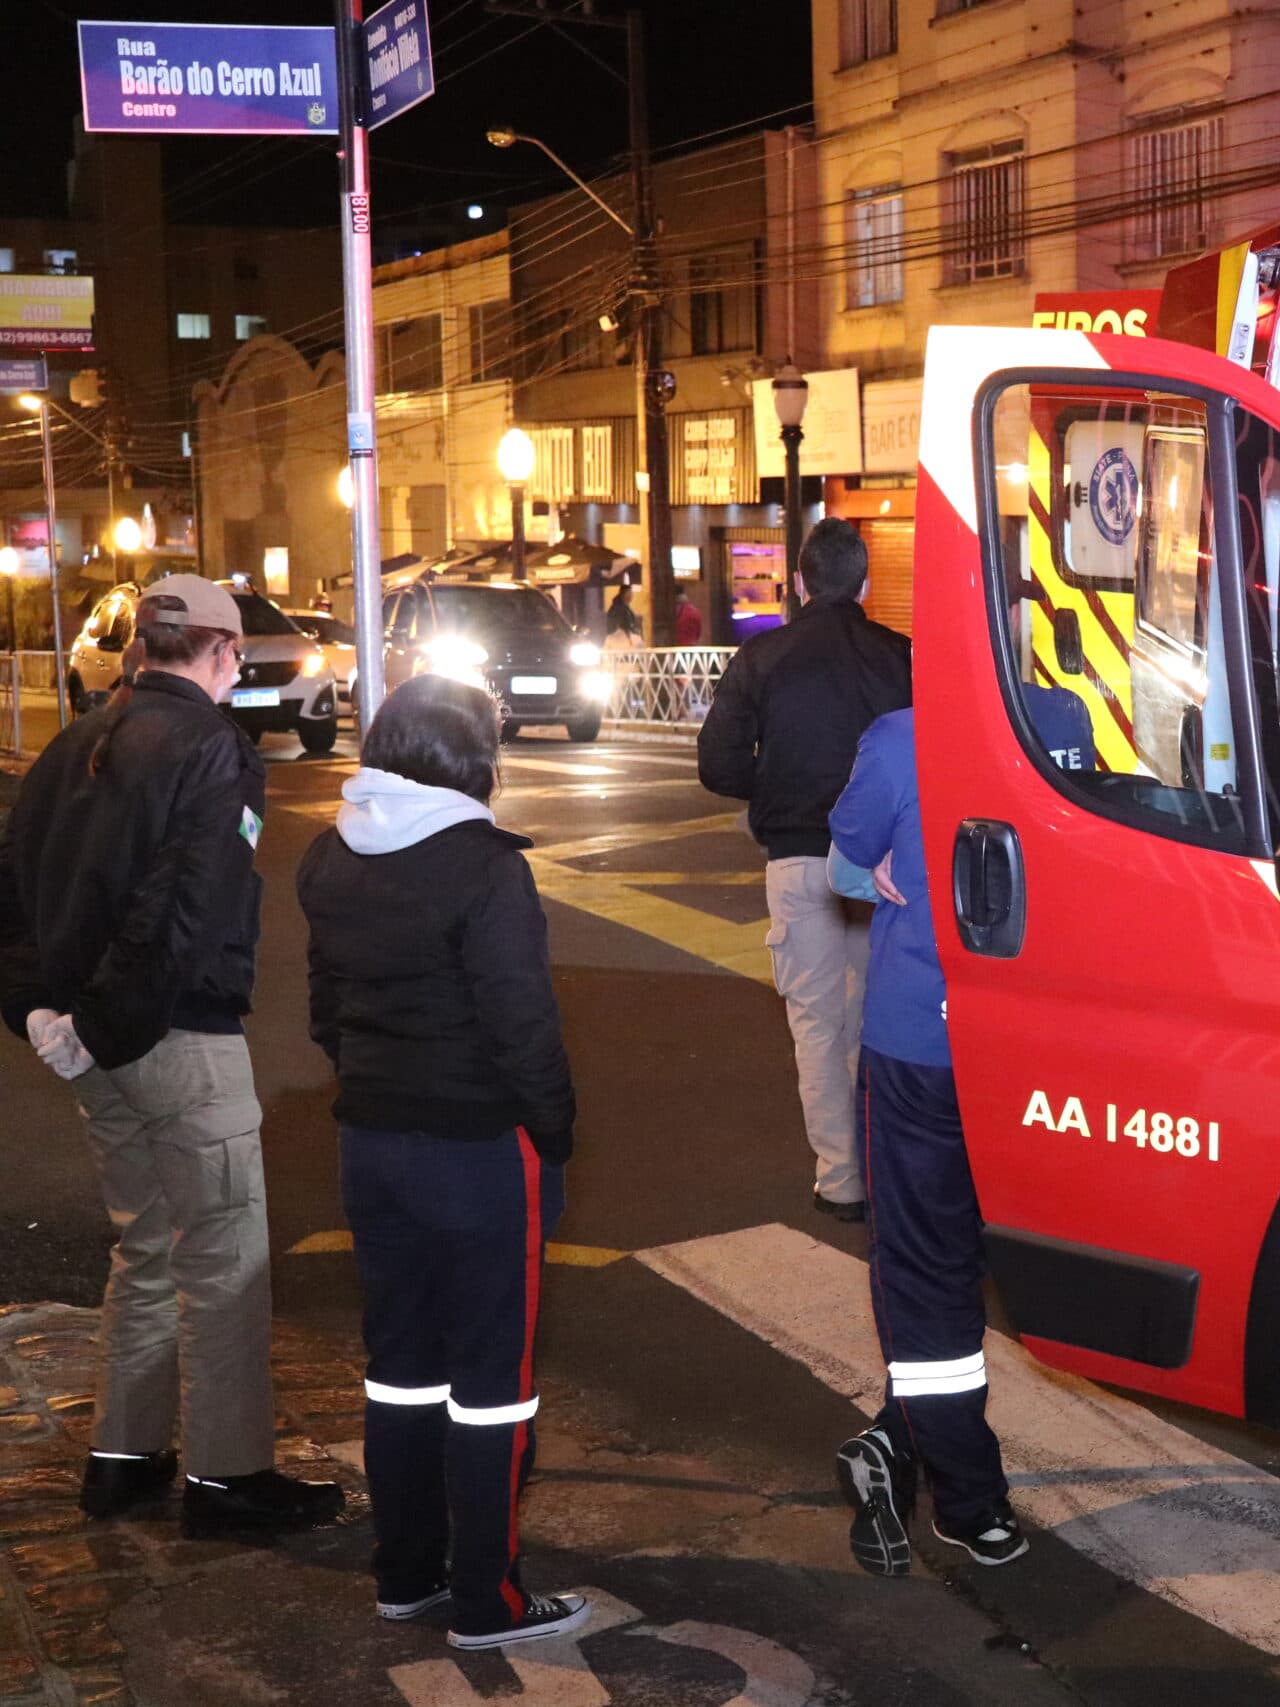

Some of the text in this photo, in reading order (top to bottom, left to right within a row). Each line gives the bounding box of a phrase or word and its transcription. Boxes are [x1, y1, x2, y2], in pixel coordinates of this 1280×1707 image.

[117, 38, 156, 56] Rua
[119, 60, 322, 97] Barão do Cerro Azul
[122, 101, 177, 117] Centro
[351, 197, 369, 232] 0018
[1048, 747, 1083, 771] TE
[1021, 1089, 1220, 1162] AA 14881
